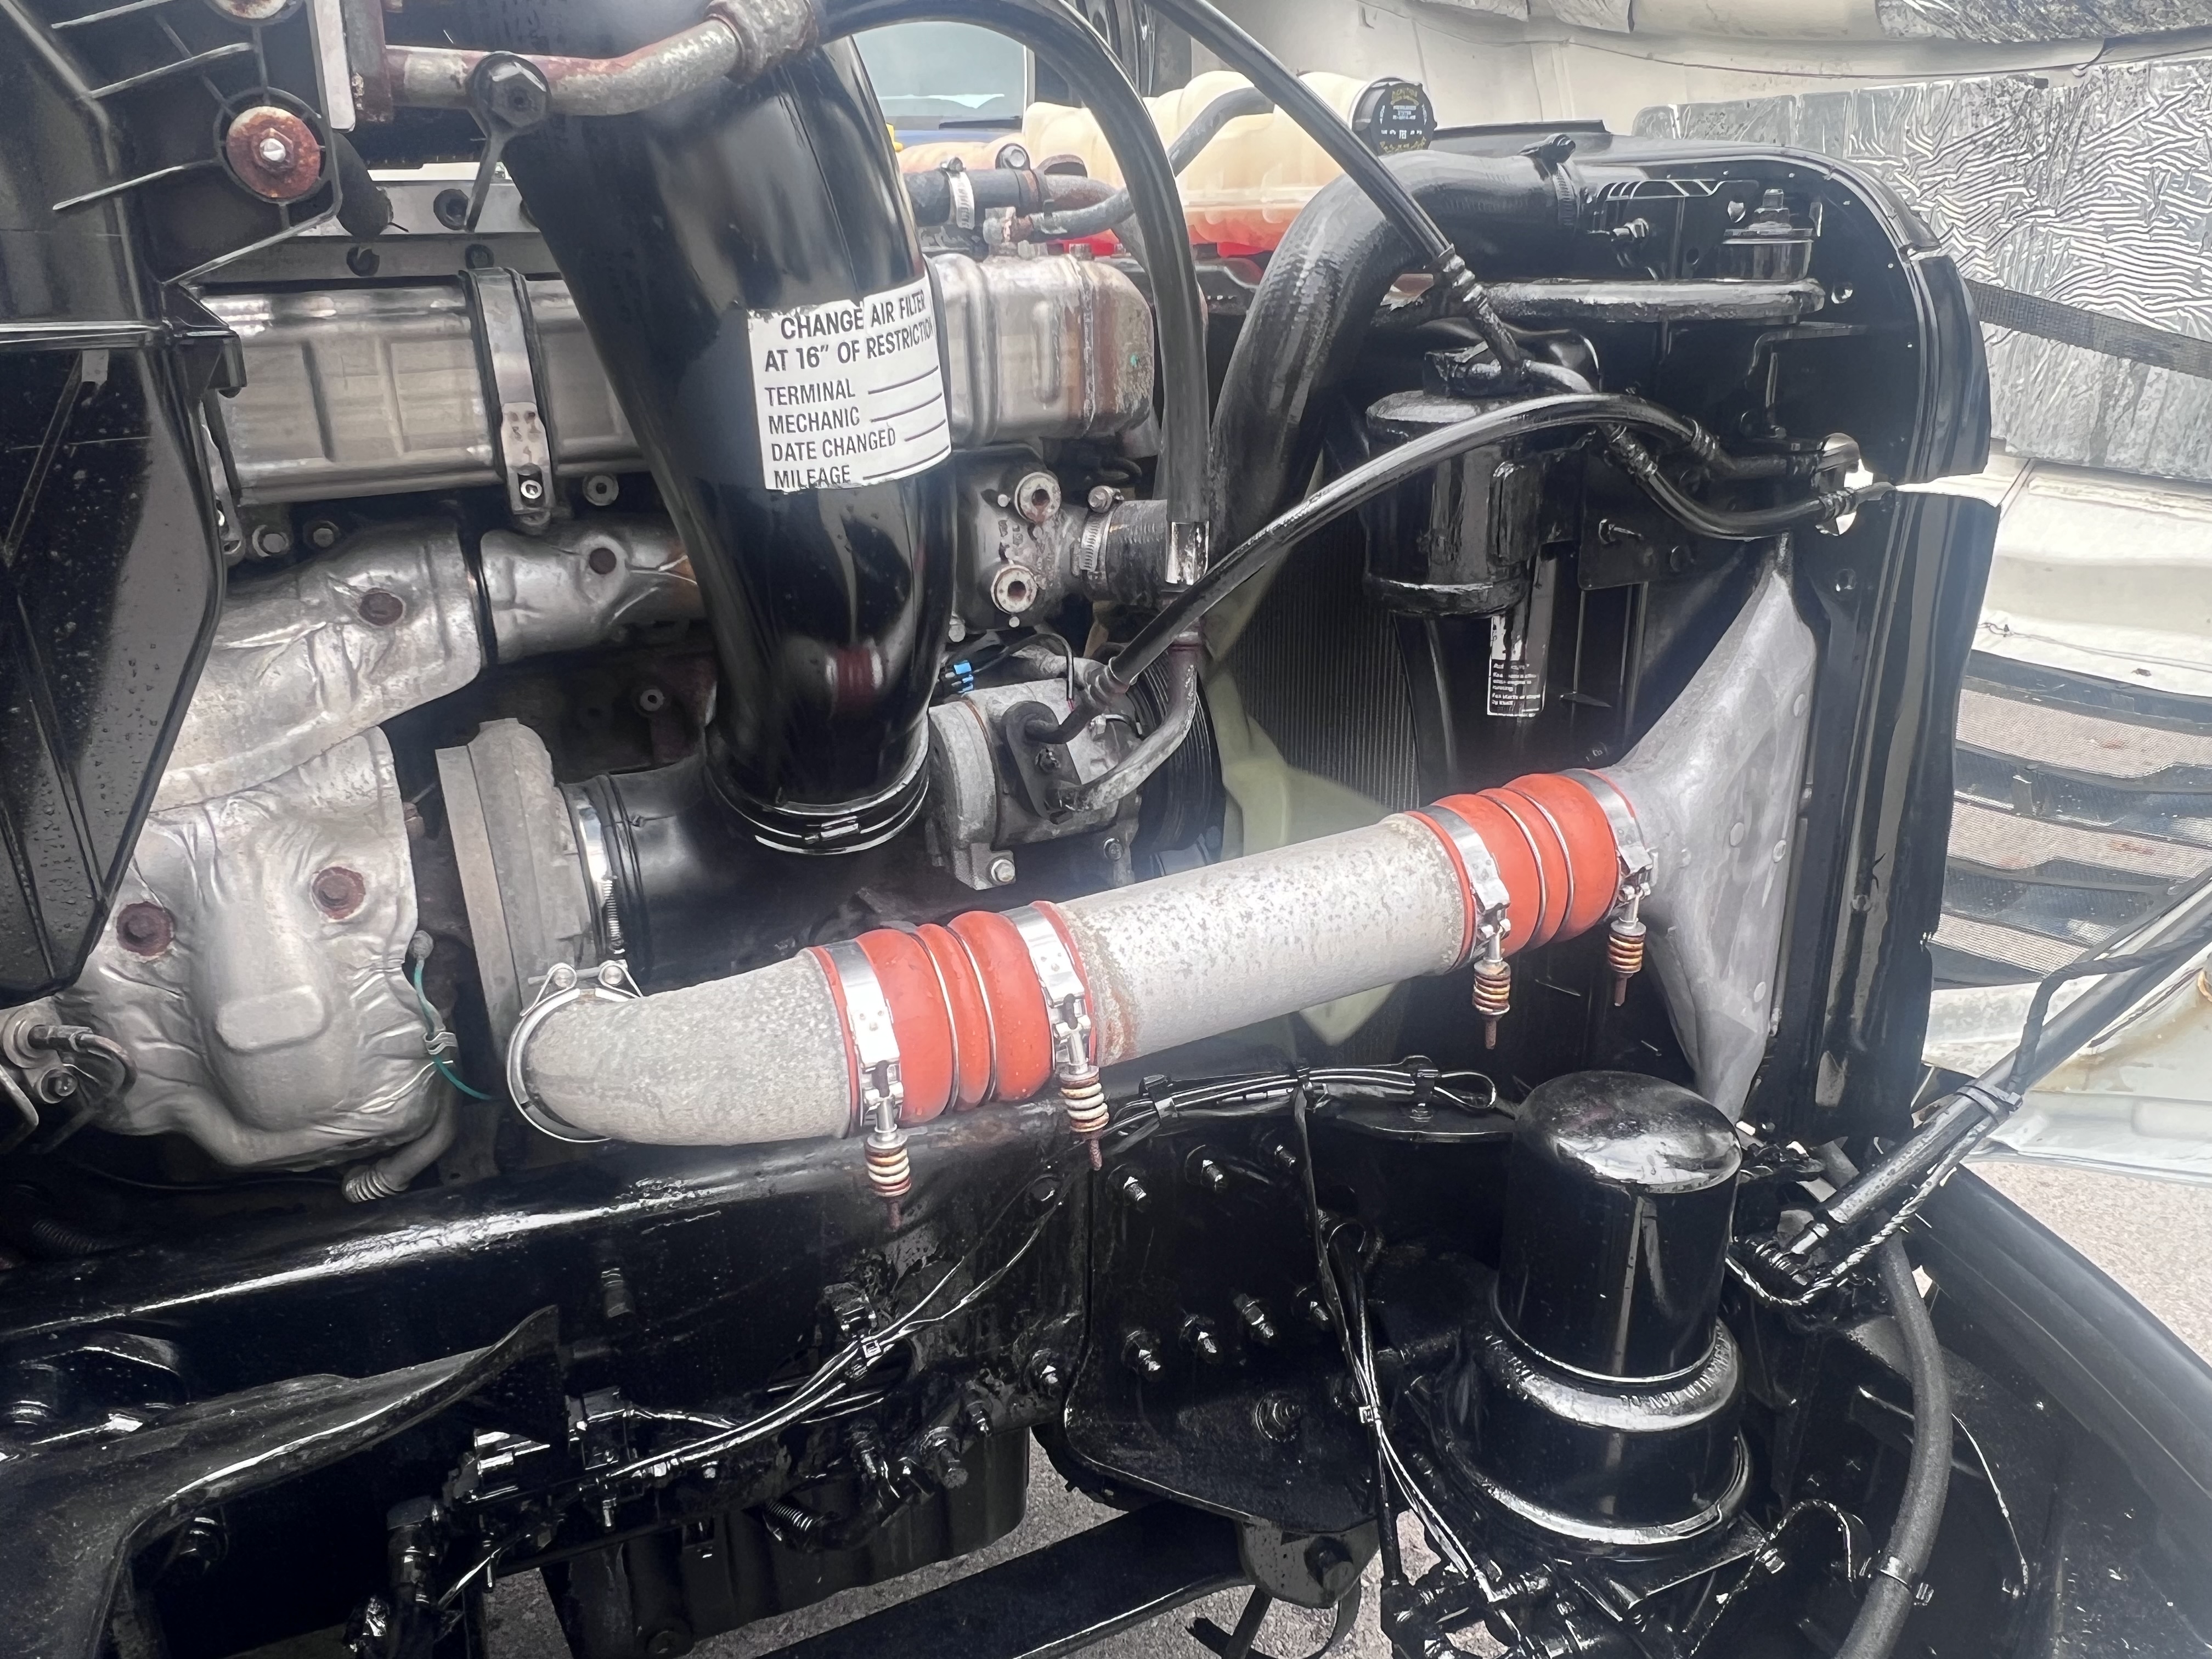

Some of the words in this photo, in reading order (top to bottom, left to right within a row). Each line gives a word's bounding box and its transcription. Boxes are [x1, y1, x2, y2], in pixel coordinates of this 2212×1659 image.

[781, 308, 864, 340] CHANGE
[871, 302, 895, 328] AIR
[899, 289, 926, 319] FILTER
[765, 349, 788, 372] AT
[838, 340, 860, 364] OF
[764, 379, 855, 406] TERMINAL
[768, 407, 860, 434] MECHANIC
[771, 442, 817, 461] DATE
[823, 428, 895, 458] CHANGED
[774, 465, 850, 489] MILEAGE
